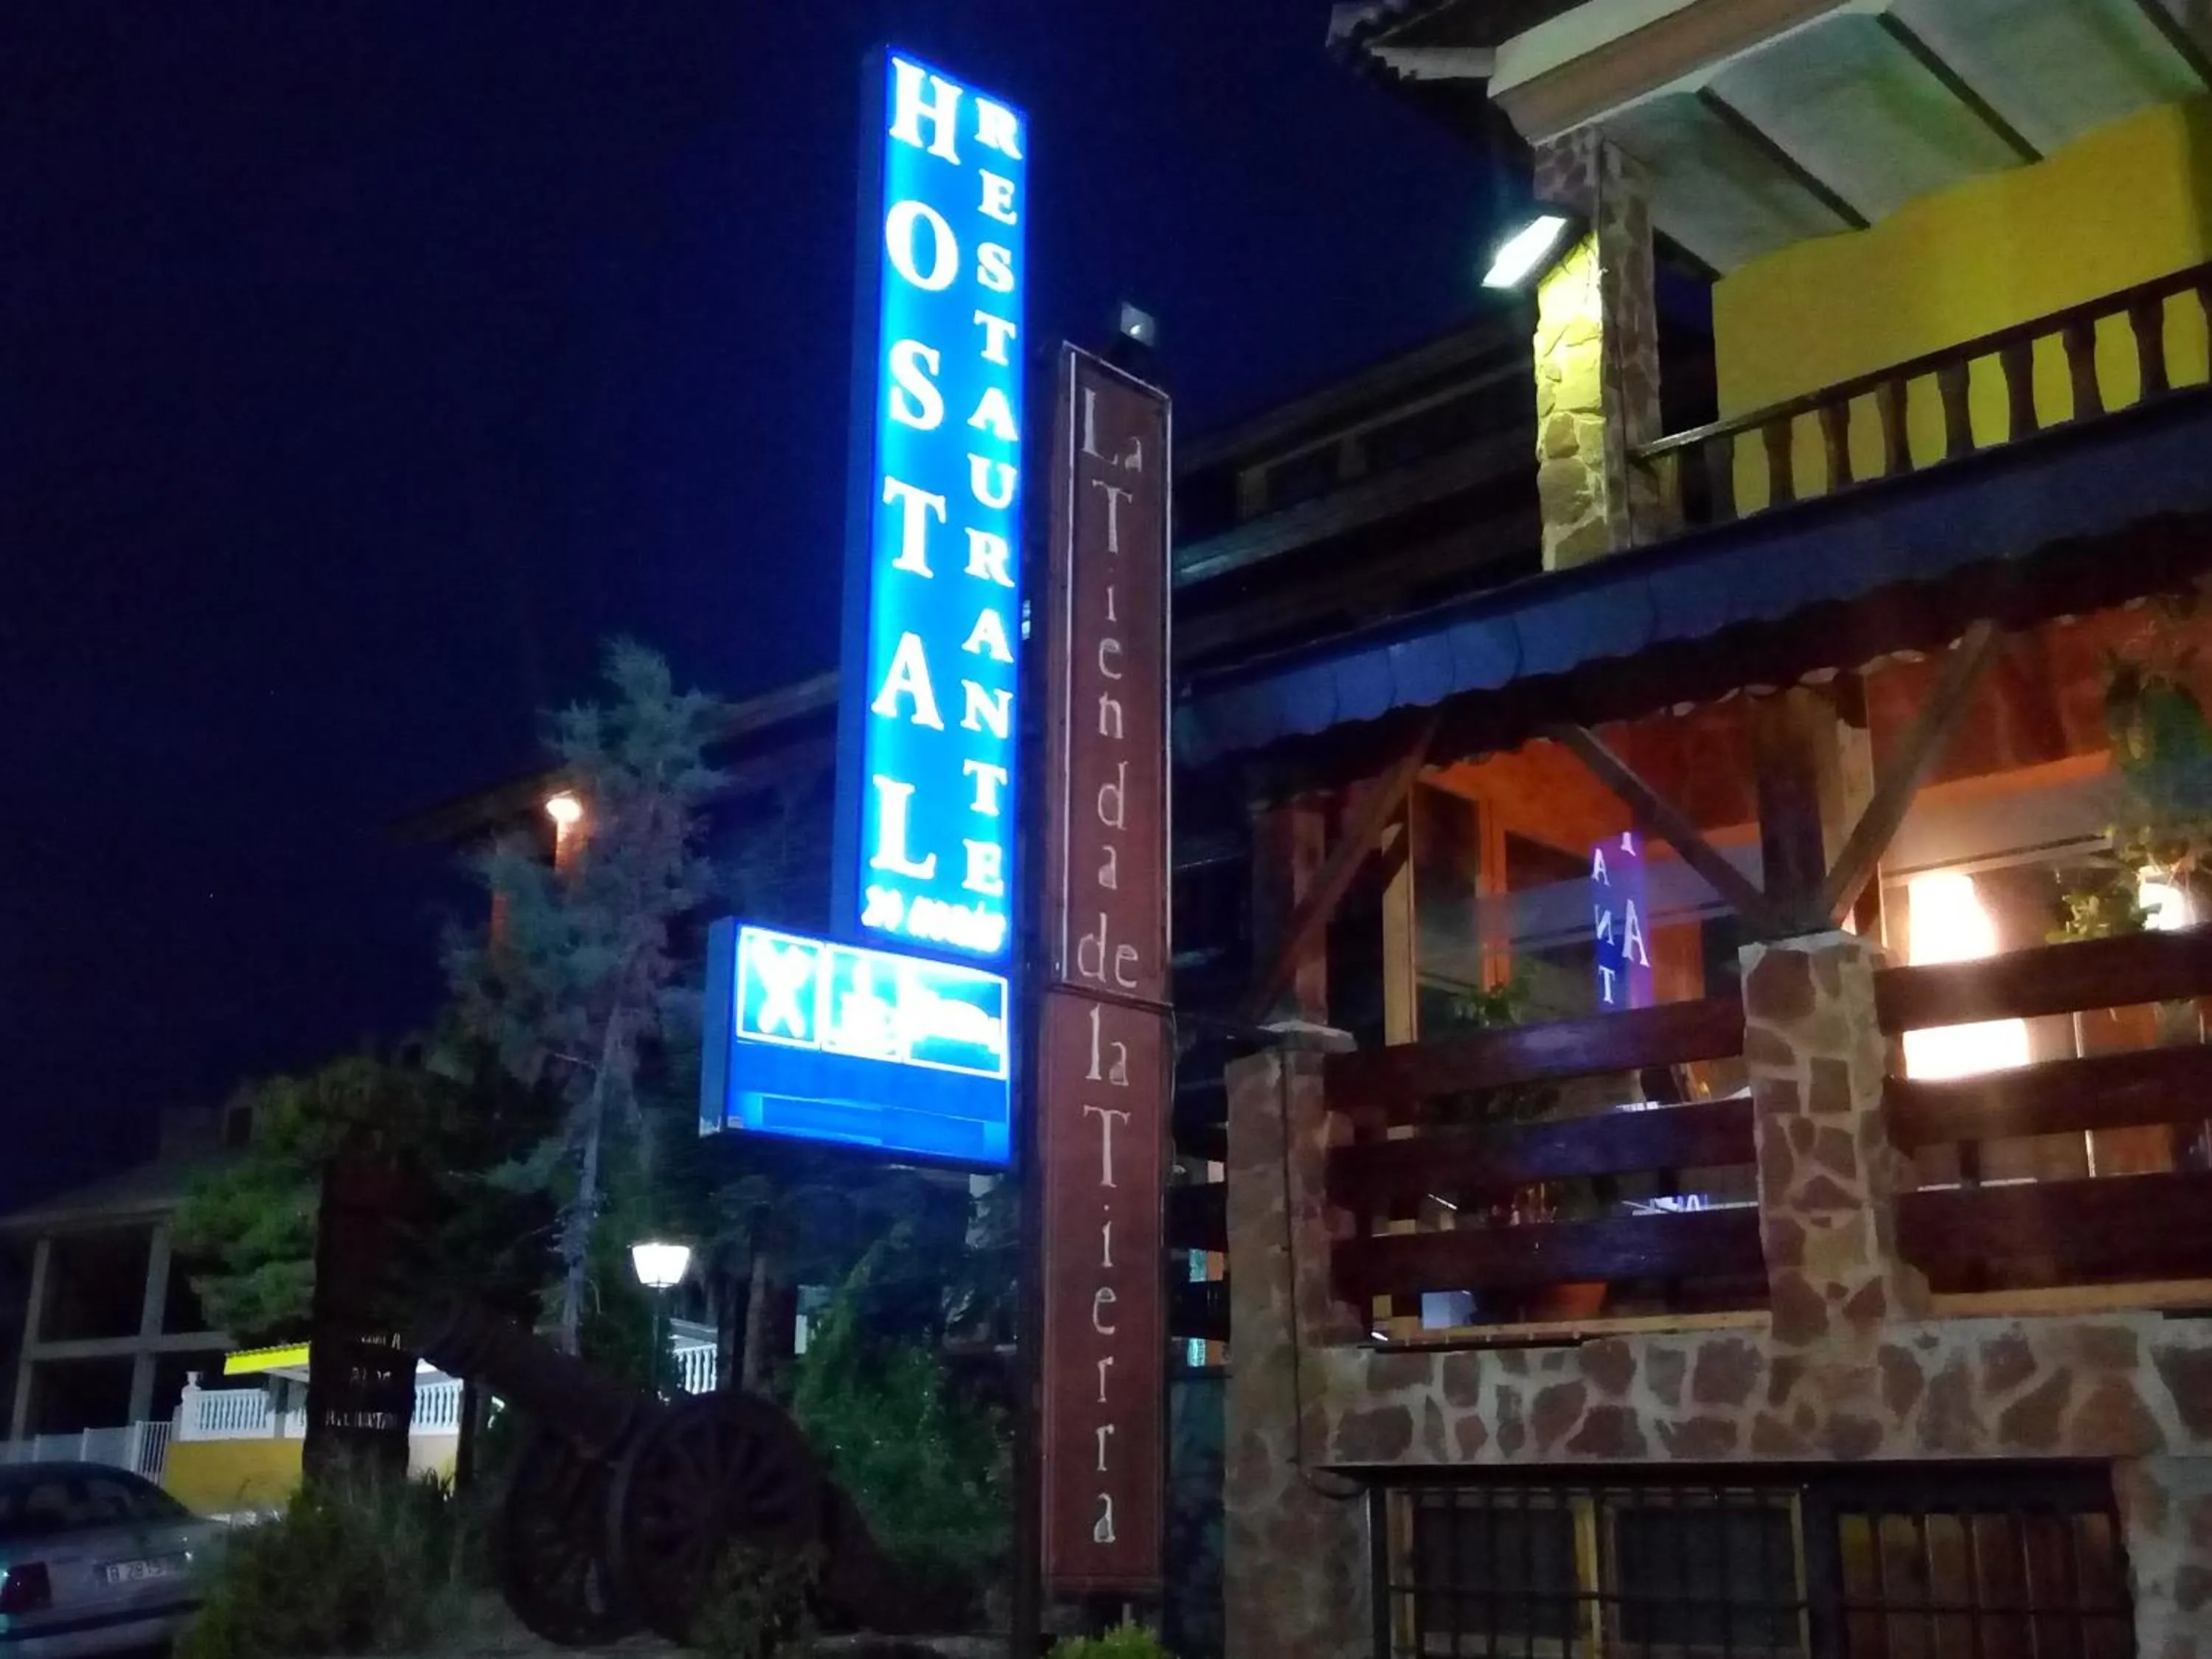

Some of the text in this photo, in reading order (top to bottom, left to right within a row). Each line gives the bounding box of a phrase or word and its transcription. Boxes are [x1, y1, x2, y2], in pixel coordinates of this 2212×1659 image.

[871, 56, 963, 880] HOSTAL
[960, 97, 1023, 897] RESTAURANTE
[1077, 387, 1143, 1543] La Tienda de la Tierra
